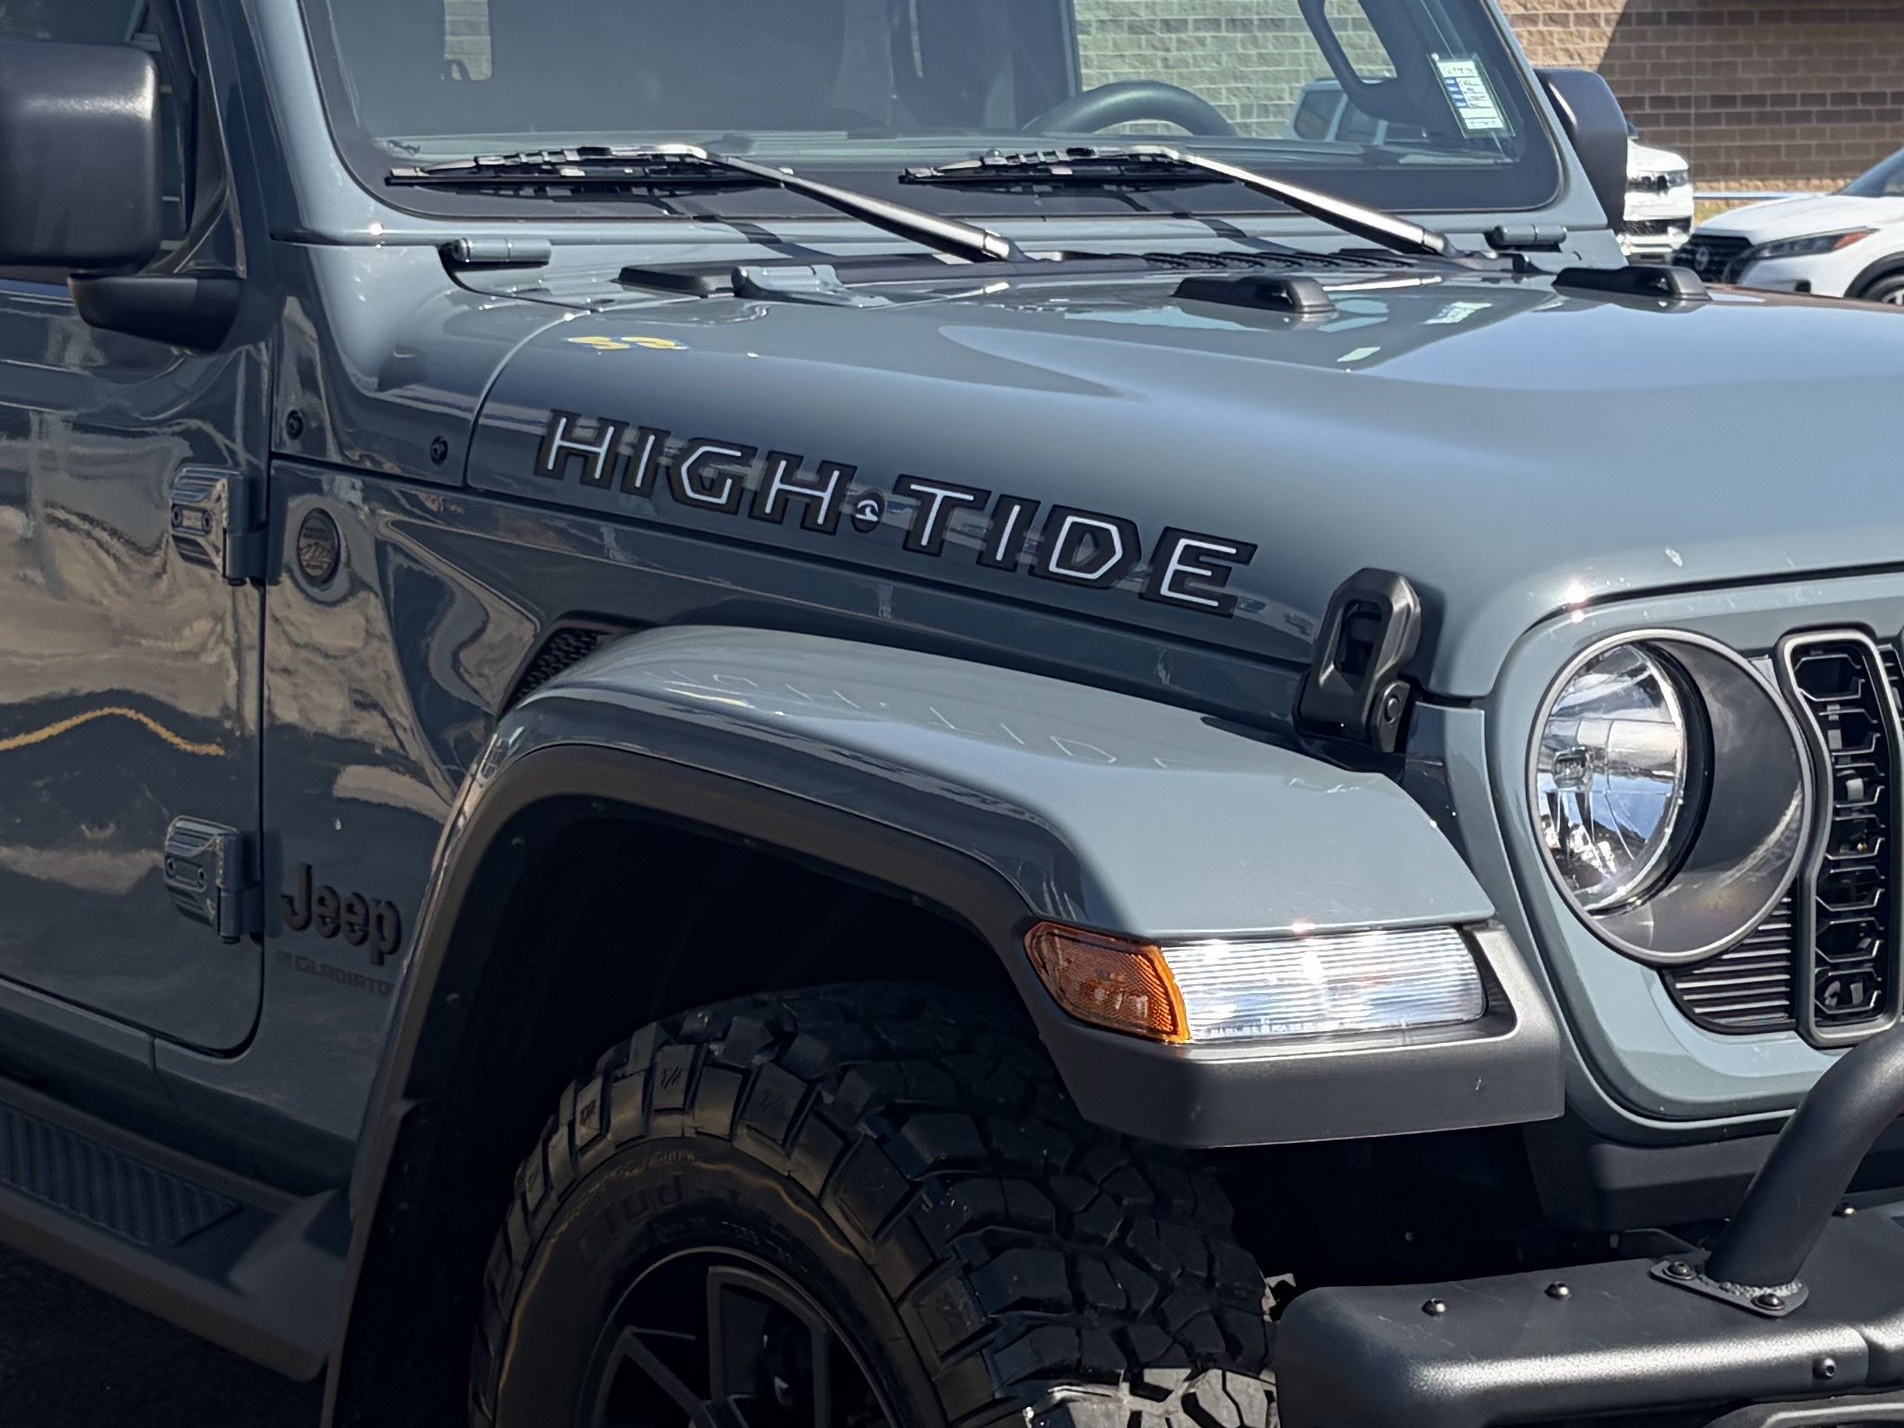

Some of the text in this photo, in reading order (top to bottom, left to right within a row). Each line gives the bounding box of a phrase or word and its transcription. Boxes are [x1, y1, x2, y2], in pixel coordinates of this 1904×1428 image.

[533, 408, 1258, 619] HIGH TIDE
[280, 862, 402, 967] Jeep
